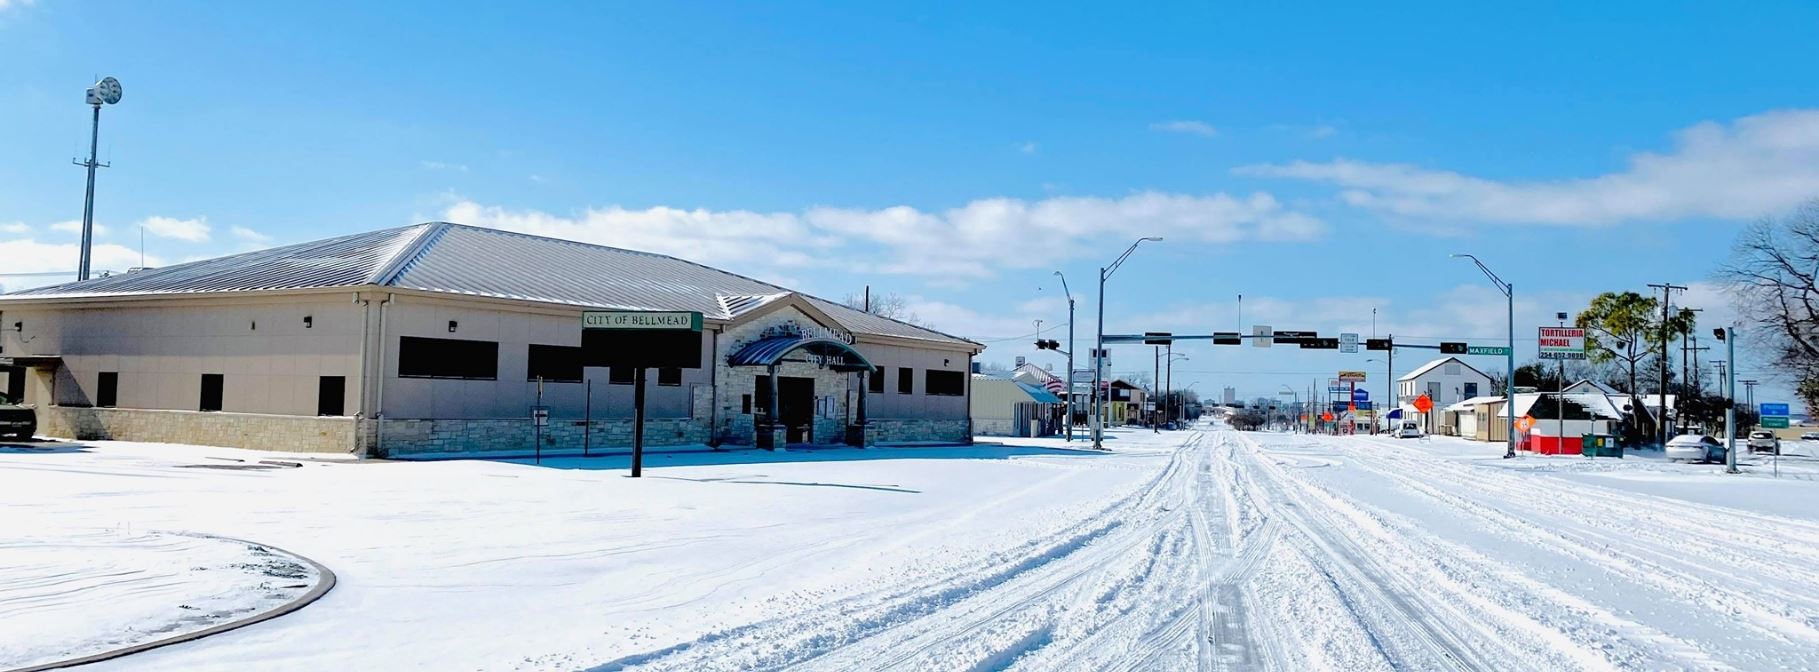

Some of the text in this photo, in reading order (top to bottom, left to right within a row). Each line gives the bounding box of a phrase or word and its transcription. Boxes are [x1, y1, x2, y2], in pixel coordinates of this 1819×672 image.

[587, 315, 688, 326] CITY OF BELLMEAD
[802, 327, 852, 344] BELLMEAD
[1541, 329, 1584, 337] TORTILLERIA
[1469, 347, 1503, 355] MAXFIELD
[805, 353, 846, 366] CITY HALL
